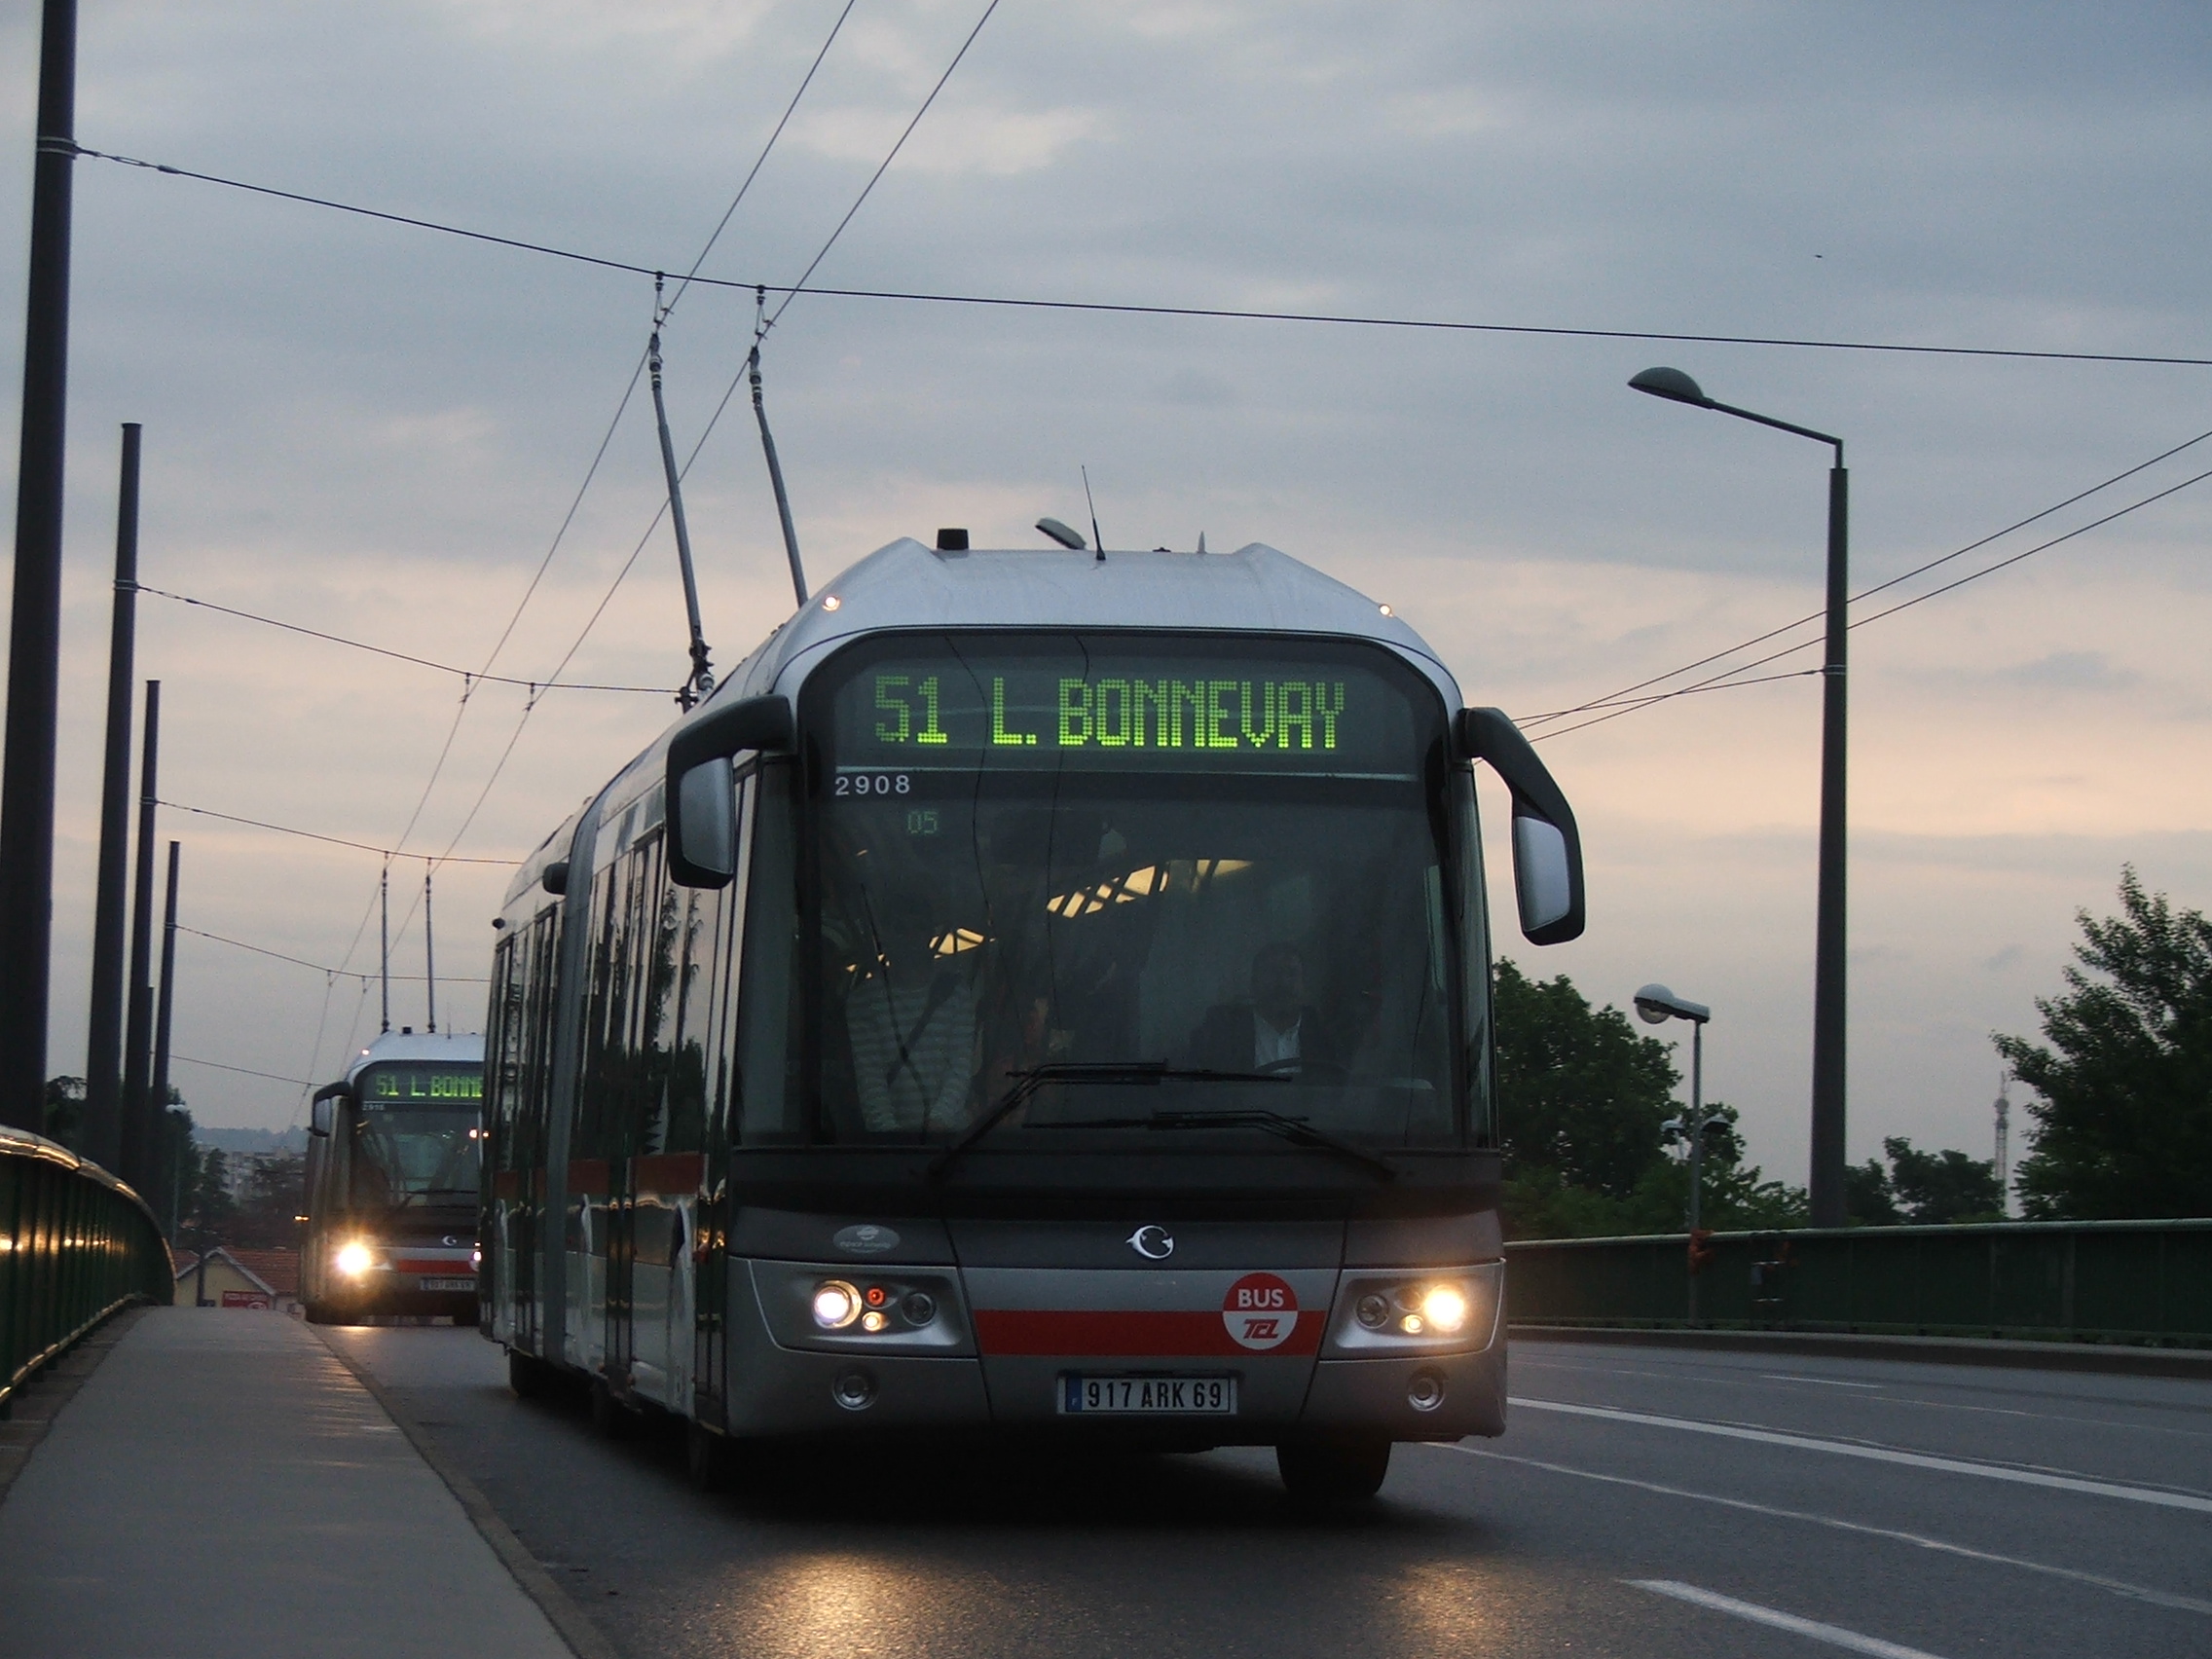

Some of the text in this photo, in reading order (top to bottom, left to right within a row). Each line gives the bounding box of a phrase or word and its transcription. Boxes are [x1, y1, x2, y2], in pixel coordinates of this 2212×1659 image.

[875, 675, 1346, 749] 51 L. BONNEVAY
[834, 775, 911, 796] 2908
[907, 810, 939, 834] 05
[375, 1074, 399, 1096] 51
[430, 1075, 483, 1098] BONNE
[1237, 1288, 1285, 1309] BUS
[1242, 1318, 1280, 1340] TCL
[1088, 1381, 1132, 1408] 917
[1140, 1381, 1186, 1408] ARK
[1193, 1381, 1223, 1408] 69
